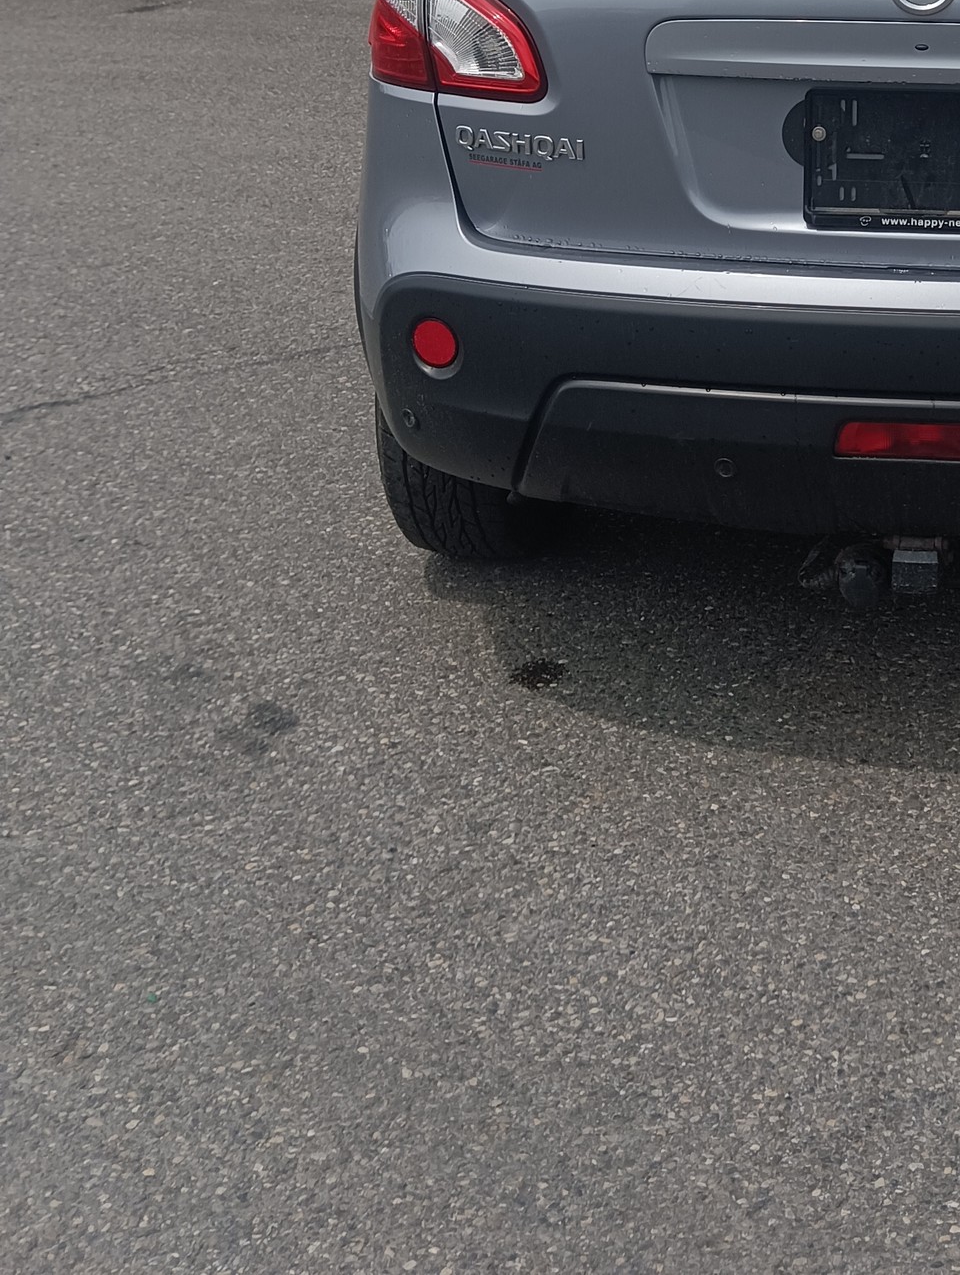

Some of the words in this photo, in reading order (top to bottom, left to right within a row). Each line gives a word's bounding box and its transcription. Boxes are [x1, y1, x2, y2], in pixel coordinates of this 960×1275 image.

[455, 124, 585, 161] QASHQAI
[468, 153, 508, 166] SEEGARAGE
[532, 161, 542, 170] AG
